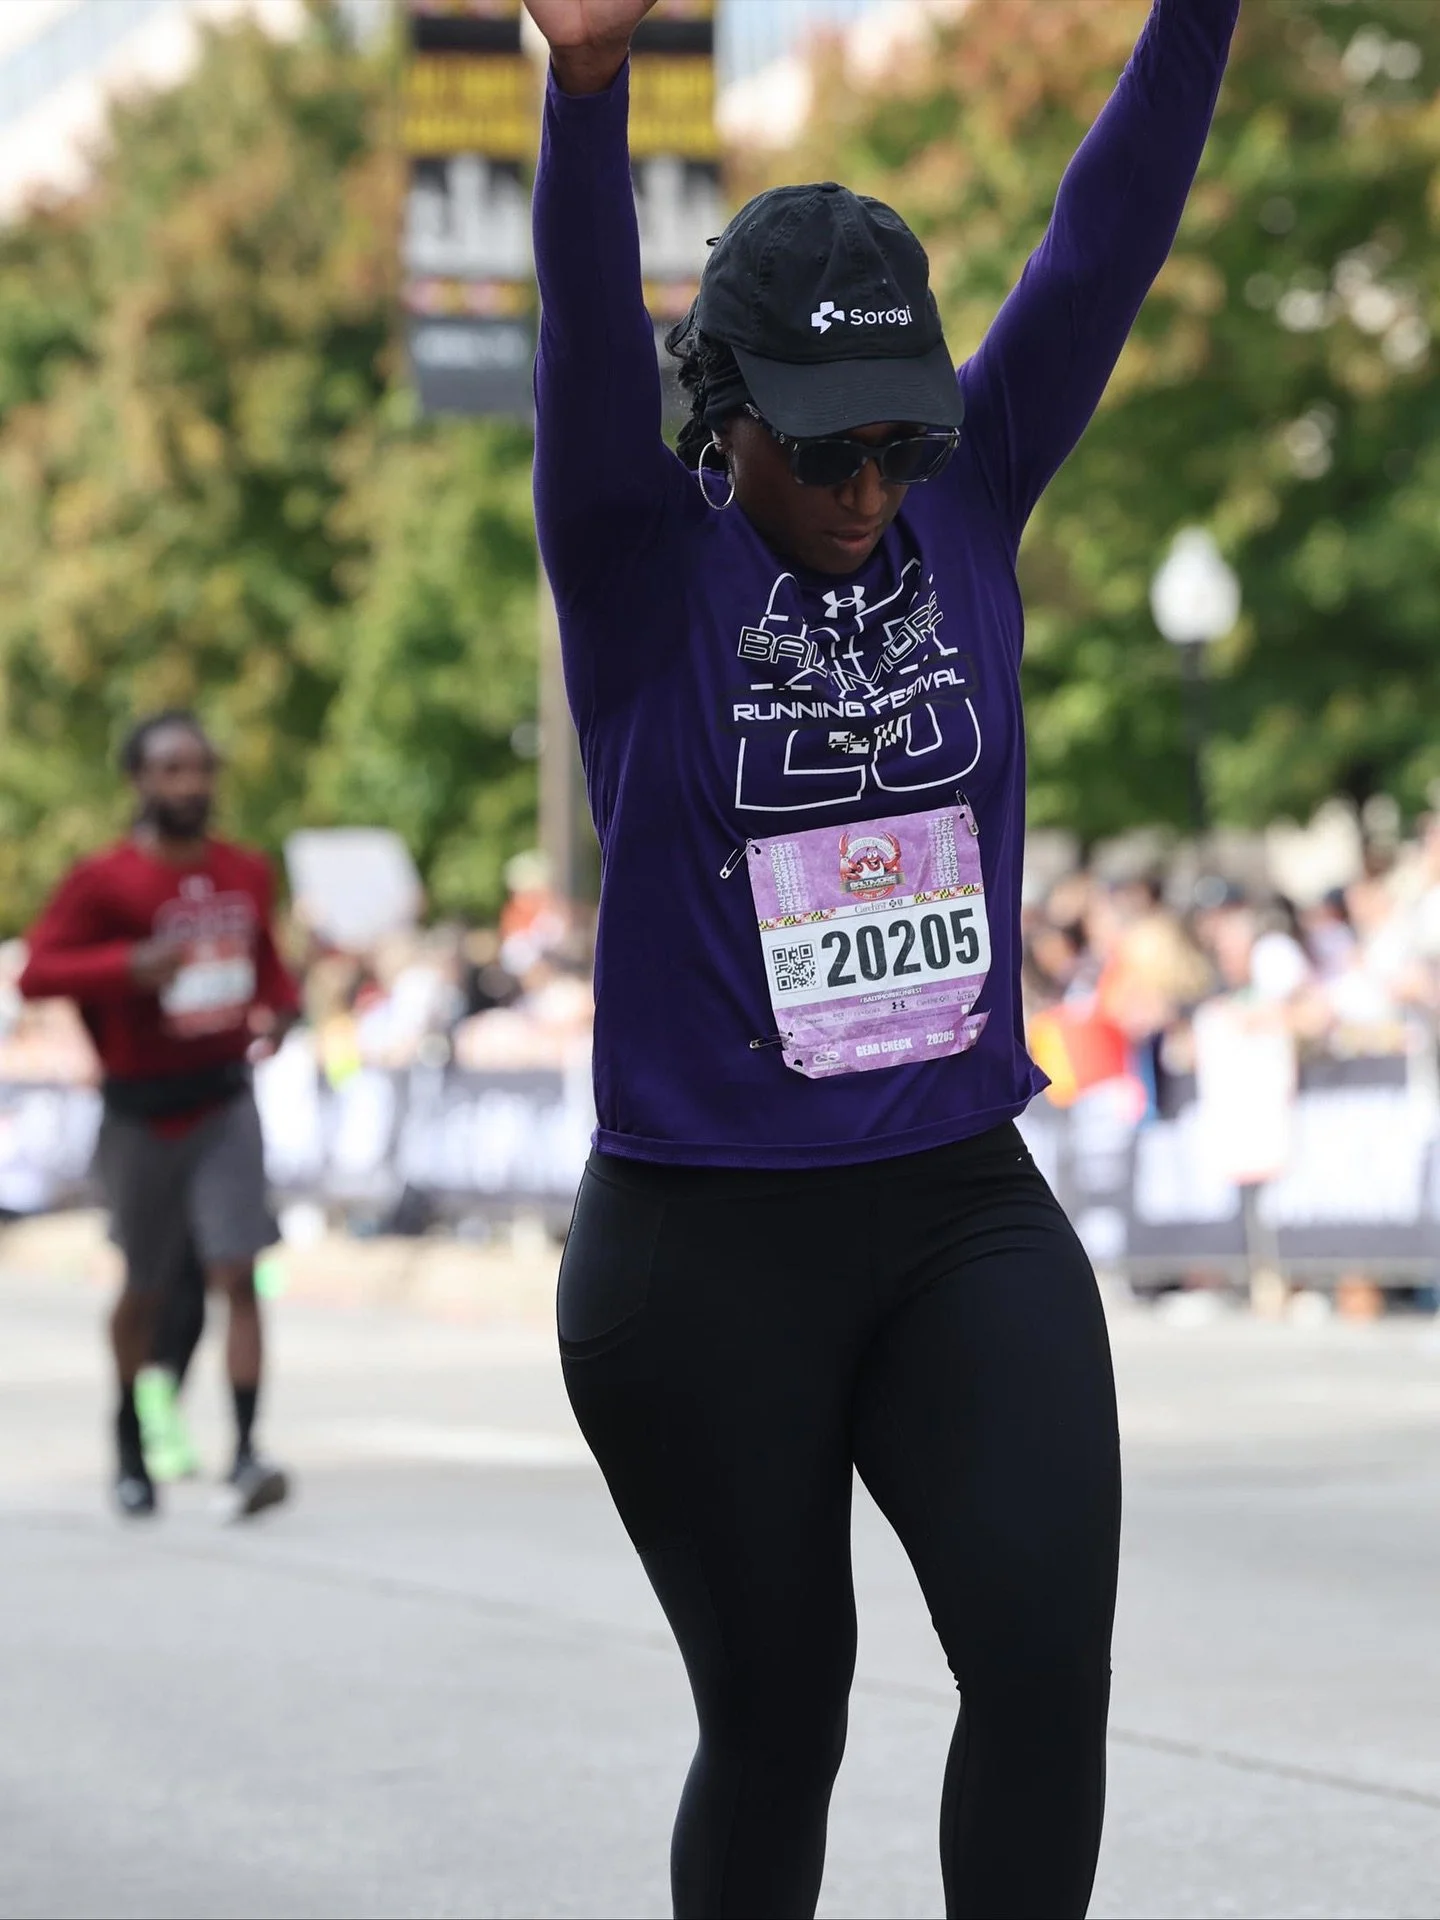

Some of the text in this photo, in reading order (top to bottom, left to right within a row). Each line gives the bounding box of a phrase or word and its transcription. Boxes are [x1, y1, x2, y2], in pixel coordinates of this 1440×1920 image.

[737, 591, 944, 691] BALIMORE
[733, 668, 966, 721] RUNNING FESTIVAL
[821, 908, 980, 988] 20205
[855, 1029, 955, 1057] GEAR CHECK 20205
